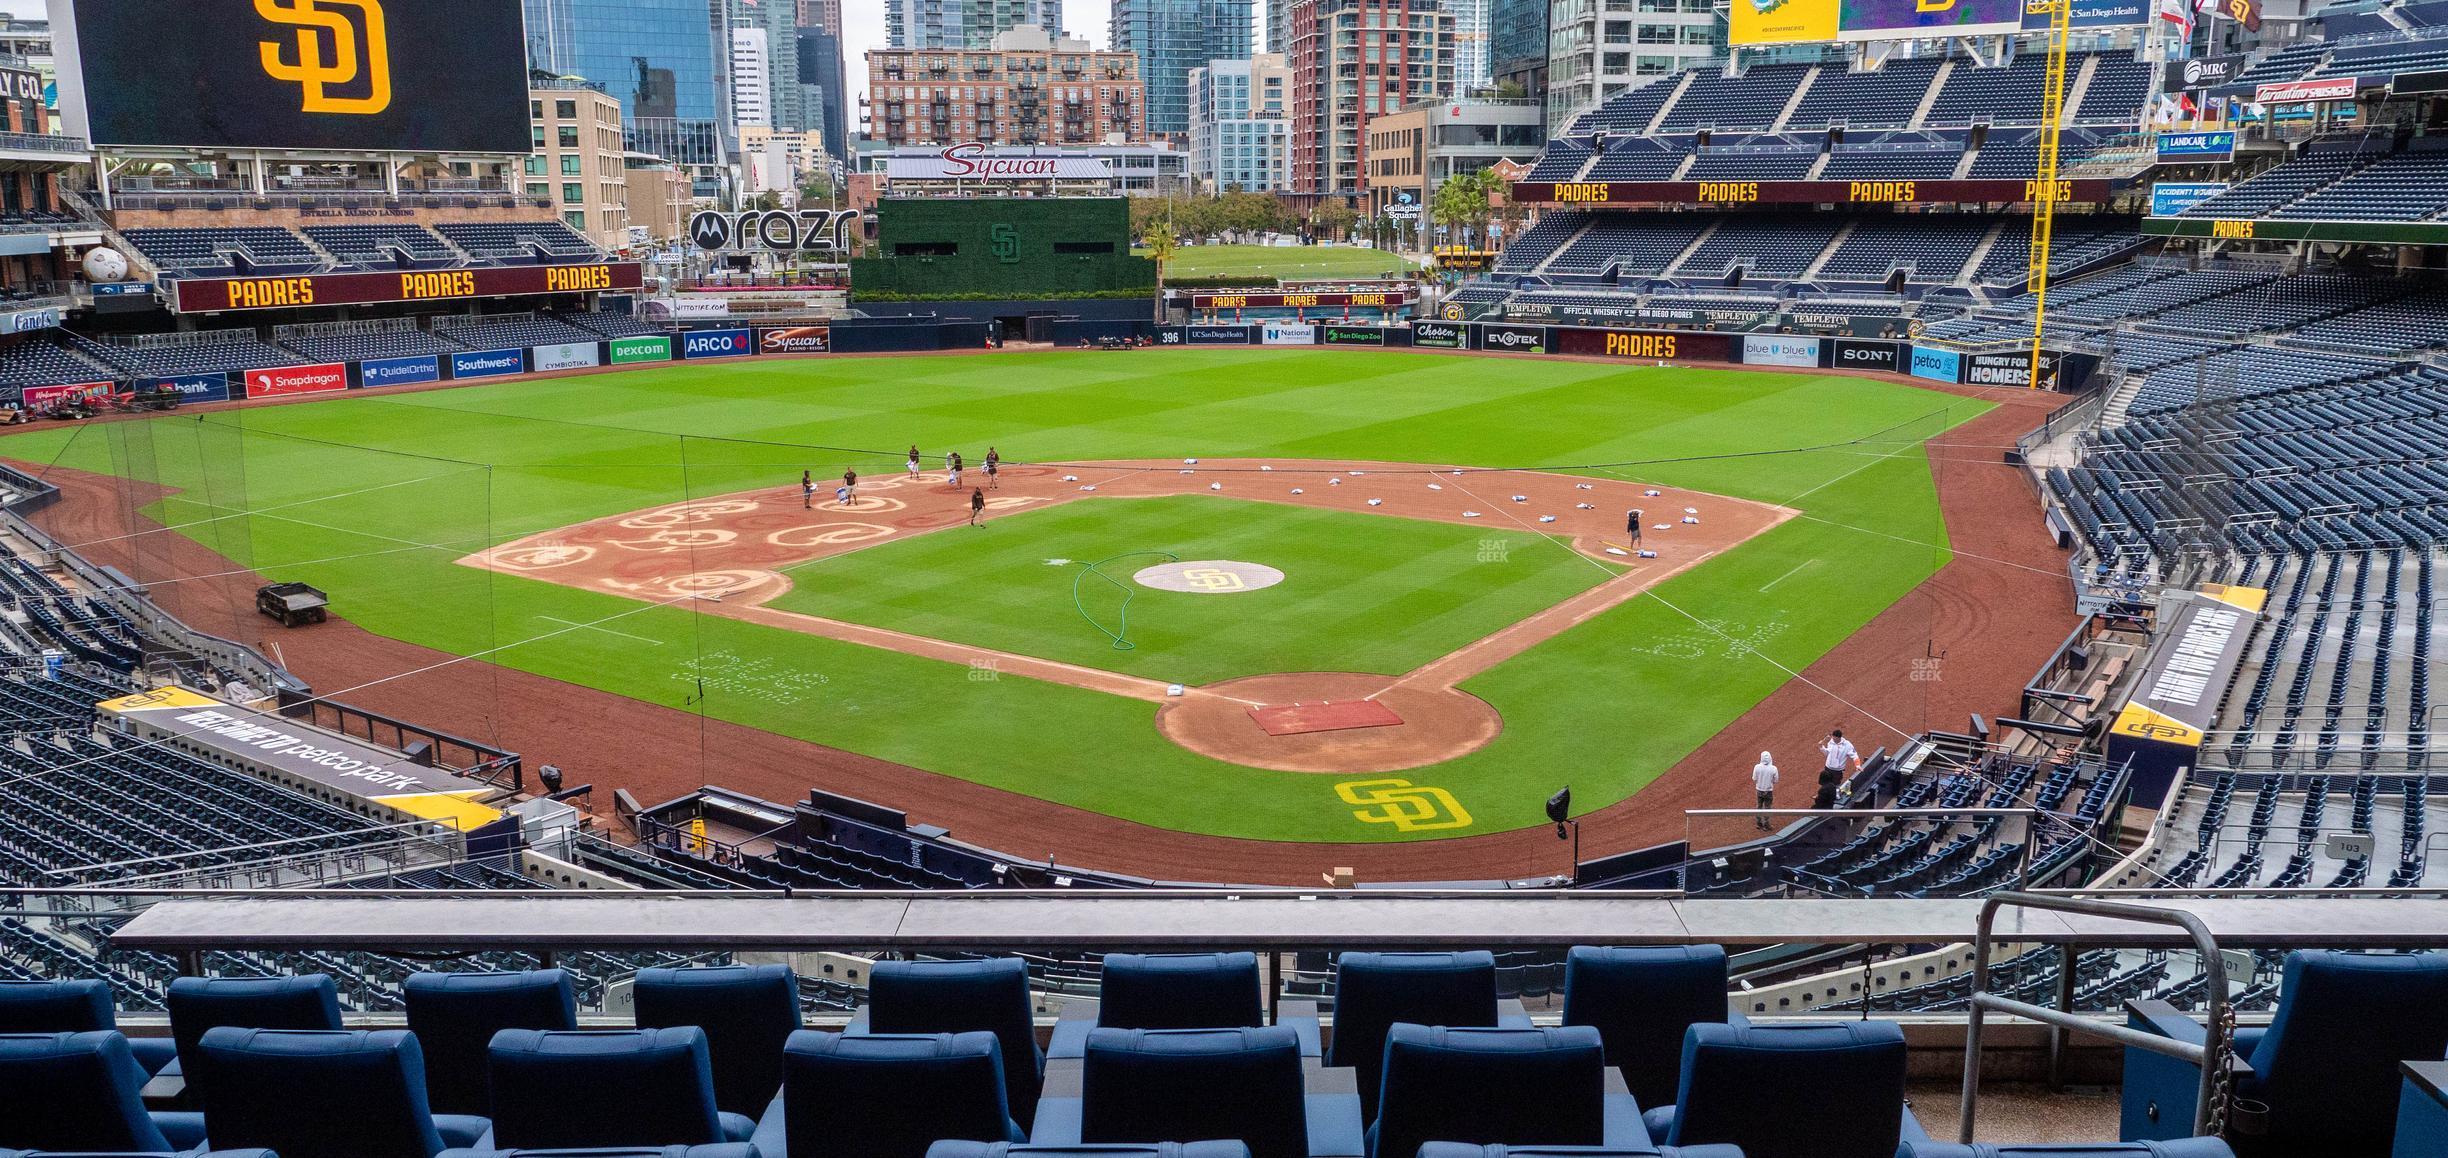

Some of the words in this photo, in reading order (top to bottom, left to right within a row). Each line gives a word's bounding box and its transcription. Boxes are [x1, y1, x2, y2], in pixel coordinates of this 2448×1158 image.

[2077, 8, 2092, 17] San
[2092, 8, 2113, 18] Diego
[2114, 6, 2138, 15] Health
[2201, 62, 2228, 76] MRC
[18, 74, 44, 100] CO.
[2258, 85, 2308, 102] Tarantino
[2170, 135, 2207, 148] LANDCARE
[2208, 134, 2232, 146] LOGIC
[943, 142, 1060, 185] Sycuan
[1555, 183, 1608, 202] PADRES
[1698, 182, 1758, 202] PADRES
[1849, 181, 1915, 202] PADRES
[1383, 204, 1422, 213] Gallagher
[1389, 211, 1417, 220] Square
[735, 209, 859, 250] razr
[2213, 220, 2254, 238] PADRES
[401, 270, 475, 299] PADRES
[546, 265, 611, 291] PADRES
[227, 278, 314, 308] PADRES
[1352, 294, 1385, 305] PADRES
[1283, 295, 1317, 306] PADRES
[1505, 303, 1552, 314] TEMPLETON
[1563, 307, 1592, 315] OFFICIAL
[1593, 308, 1623, 316] WHISKEY
[1651, 310, 1669, 318] DIEGO
[1670, 311, 1693, 319] PADRES
[14, 311, 51, 331] Canel's
[1704, 311, 1759, 322] TEMPLETON
[1793, 314, 1850, 326] TEMPLETON
[1162, 332, 1179, 343] 396
[1211, 331, 1227, 339] Diego
[1351, 333, 1368, 341] Diego
[1417, 324, 1455, 337] Chosen
[687, 337, 732, 352] ARCO
[764, 330, 823, 351] Sycuan
[1489, 332, 1538, 346] EVOTEK
[1605, 332, 1677, 358] PADRES
[1746, 343, 1769, 353] blue
[1782, 345, 1806, 355] blue
[1844, 349, 1893, 361] SONY
[457, 357, 512, 372] Southwest
[545, 360, 589, 370] CYMBIOTIKA
[1914, 354, 1942, 370] petco
[1975, 356, 2010, 367] HUNGRY
[2011, 357, 2028, 367] FOR
[380, 364, 435, 377] QuidelOrtho
[1970, 366, 2031, 385] HOMERS
[174, 381, 209, 394] bank
[275, 374, 340, 387] Snapdragon
[2175, 622, 2234, 660] PADRES
[2165, 652, 2219, 676] YOU
[2148, 668, 2211, 708] THANK
[174, 710, 281, 742] WELCOME
[250, 734, 302, 749] TO
[273, 743, 363, 771] petco
[340, 764, 424, 790] park
[2341, 842, 2360, 853] 103
[2226, 960, 2238, 972] 01
[620, 992, 635, 1006] 10
